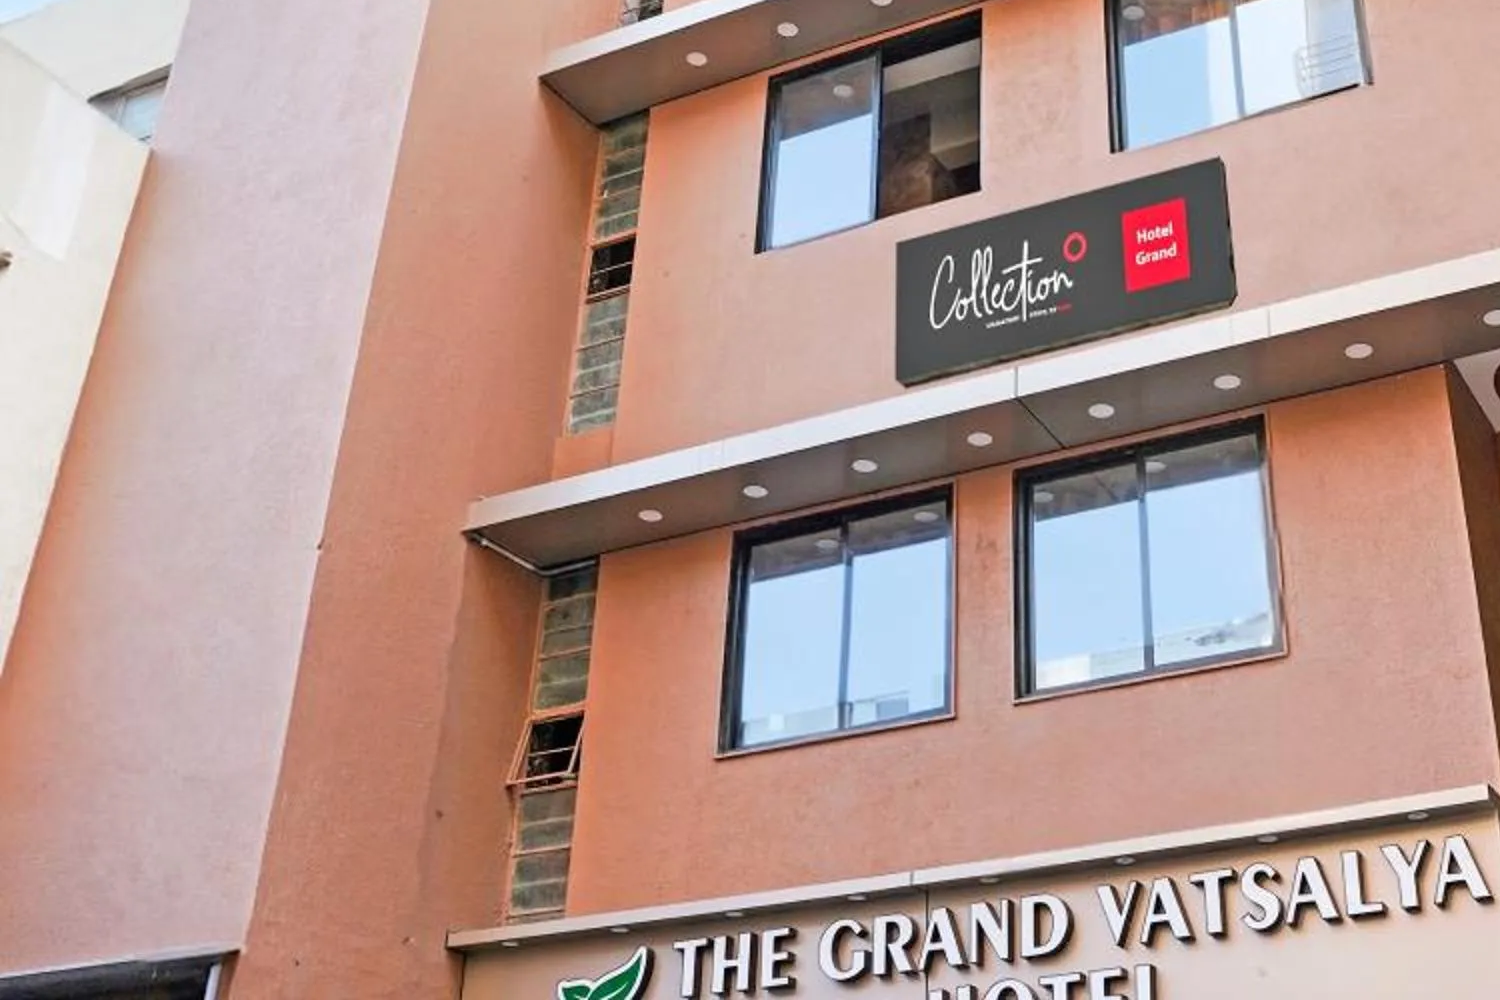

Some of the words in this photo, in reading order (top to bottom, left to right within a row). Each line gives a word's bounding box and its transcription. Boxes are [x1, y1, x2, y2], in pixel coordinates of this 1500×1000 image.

[1135, 241, 1178, 265] Grand
[1136, 220, 1174, 245] Hotel
[929, 239, 1074, 330] Collection
[673, 926, 796, 999] THE
[818, 893, 1074, 983] GRAND
[1097, 833, 1495, 949] VATSALYA
